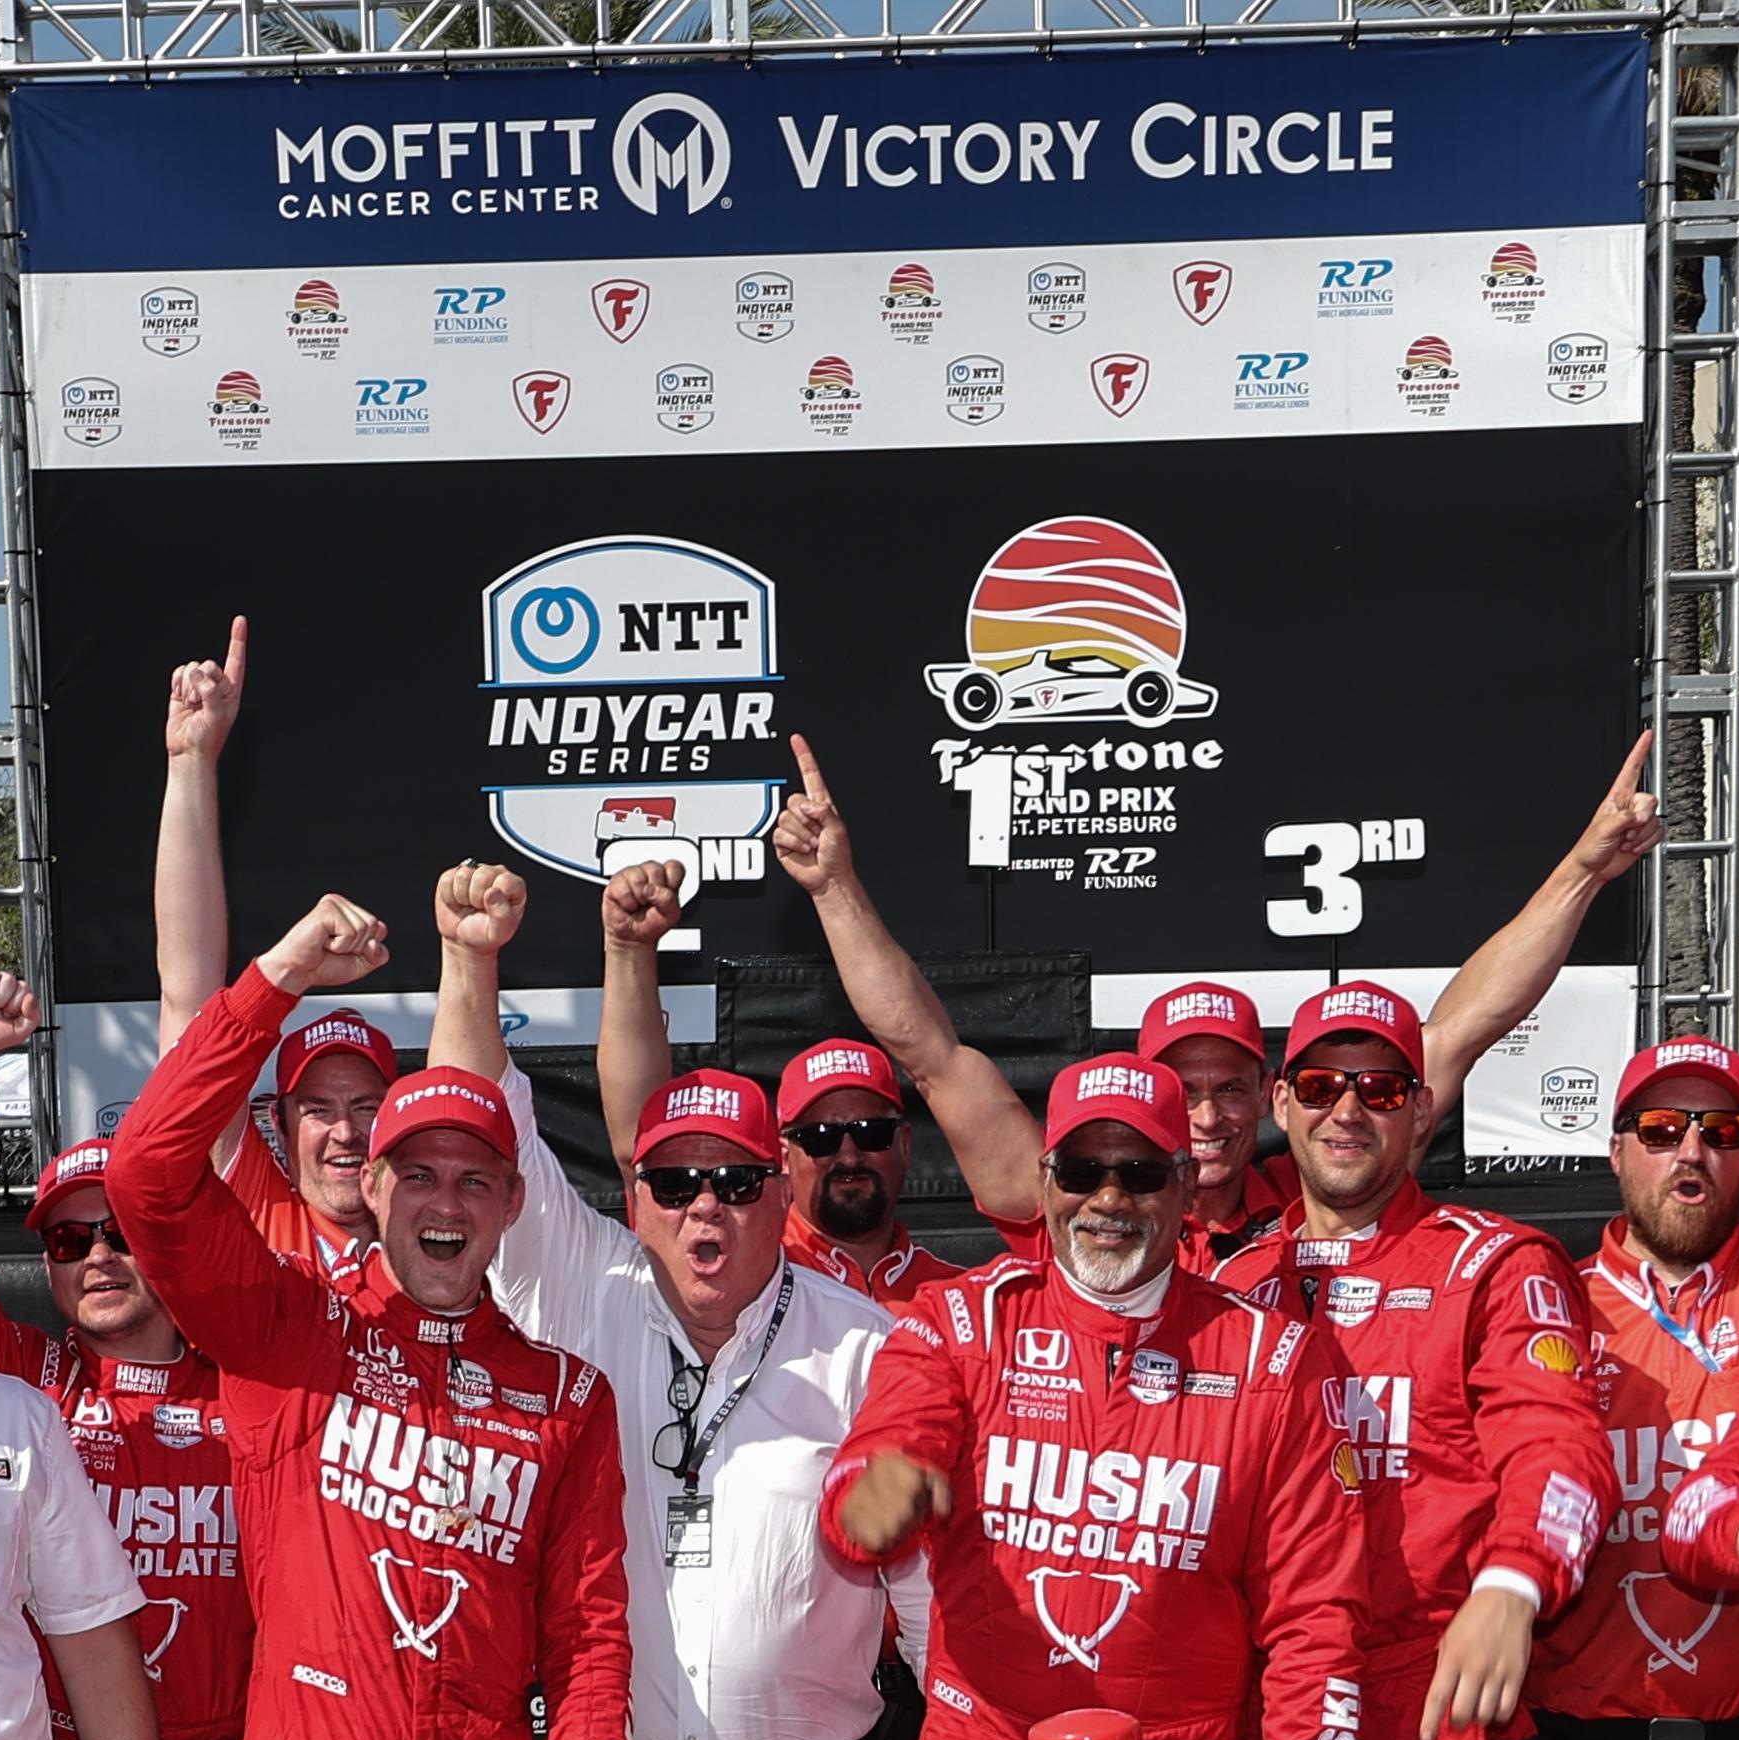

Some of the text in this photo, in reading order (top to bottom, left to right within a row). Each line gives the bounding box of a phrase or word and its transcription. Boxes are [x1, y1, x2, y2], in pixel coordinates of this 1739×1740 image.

[276, 118, 597, 184] MOFFITT
[778, 102, 1395, 189] VICTORY CIRCLE
[278, 185, 600, 220] CANCER CENTER
[1054, 275, 1081, 287] NTT
[1318, 259, 1393, 287] RP
[433, 287, 507, 315] RP
[761, 284, 788, 296] NTT
[1028, 293, 1085, 306] INDYCAR
[1318, 289, 1394, 305] FUNDING
[1481, 288, 1546, 301] Firestone
[167, 299, 194, 312] NTT
[736, 302, 793, 315] INDYCAR
[880, 310, 943, 321] Firestone
[142, 317, 199, 330] INDYCAR
[286, 325, 350, 337] Firestone
[433, 316, 509, 332] FUNDING
[433, 334, 509, 345] DIRECT MORTGAGE LENDER
[355, 378, 428, 406] RP
[1235, 382, 1310, 398] FUNDING
[1397, 382, 1461, 394] Firestone
[355, 408, 430, 423] FUNDING
[618, 602, 748, 654] NTT
[488, 692, 773, 746] INDYCAR
[547, 745, 712, 776] SERIES
[954, 752, 1073, 868] 1ST
[1099, 786, 1176, 812] PRIX
[1084, 847, 1157, 874] RP
[1055, 870, 1074, 881] BY
[1084, 875, 1158, 890] FUNDING
[1264, 818, 1426, 937] 3RD
[1165, 992, 1234, 1016] HUSKI
[1321, 991, 1394, 1018] HUSKI
[305, 1021, 370, 1046] HUSKI
[806, 1050, 868, 1075] HUSKI
[1655, 1044, 1730, 1069] HUSKI
[1078, 1066, 1153, 1095] HUSKI
[394, 1085, 497, 1113] Firestone
[667, 1086, 740, 1111] HUSKI
[1540, 1095, 1598, 1106] INDYCAR
[1296, 1240, 1351, 1258] HUSKI
[116, 1364, 170, 1387] HUSKI
[1002, 1367, 1085, 1394] HONDA
[713, 1393, 741, 1424] 2023
[1006, 1404, 1068, 1423] LEGION
[486, 1420, 542, 1445] ERICSSON
[319, 1392, 540, 1529] HUSKI
[982, 1435, 1222, 1536] HUSKI
[319, 1465, 522, 1565] CHOCOLATE
[982, 1511, 1206, 1572] CHOCOLATE
[672, 1553, 709, 1567] 2023
[291, 1664, 348, 1696] sparco
